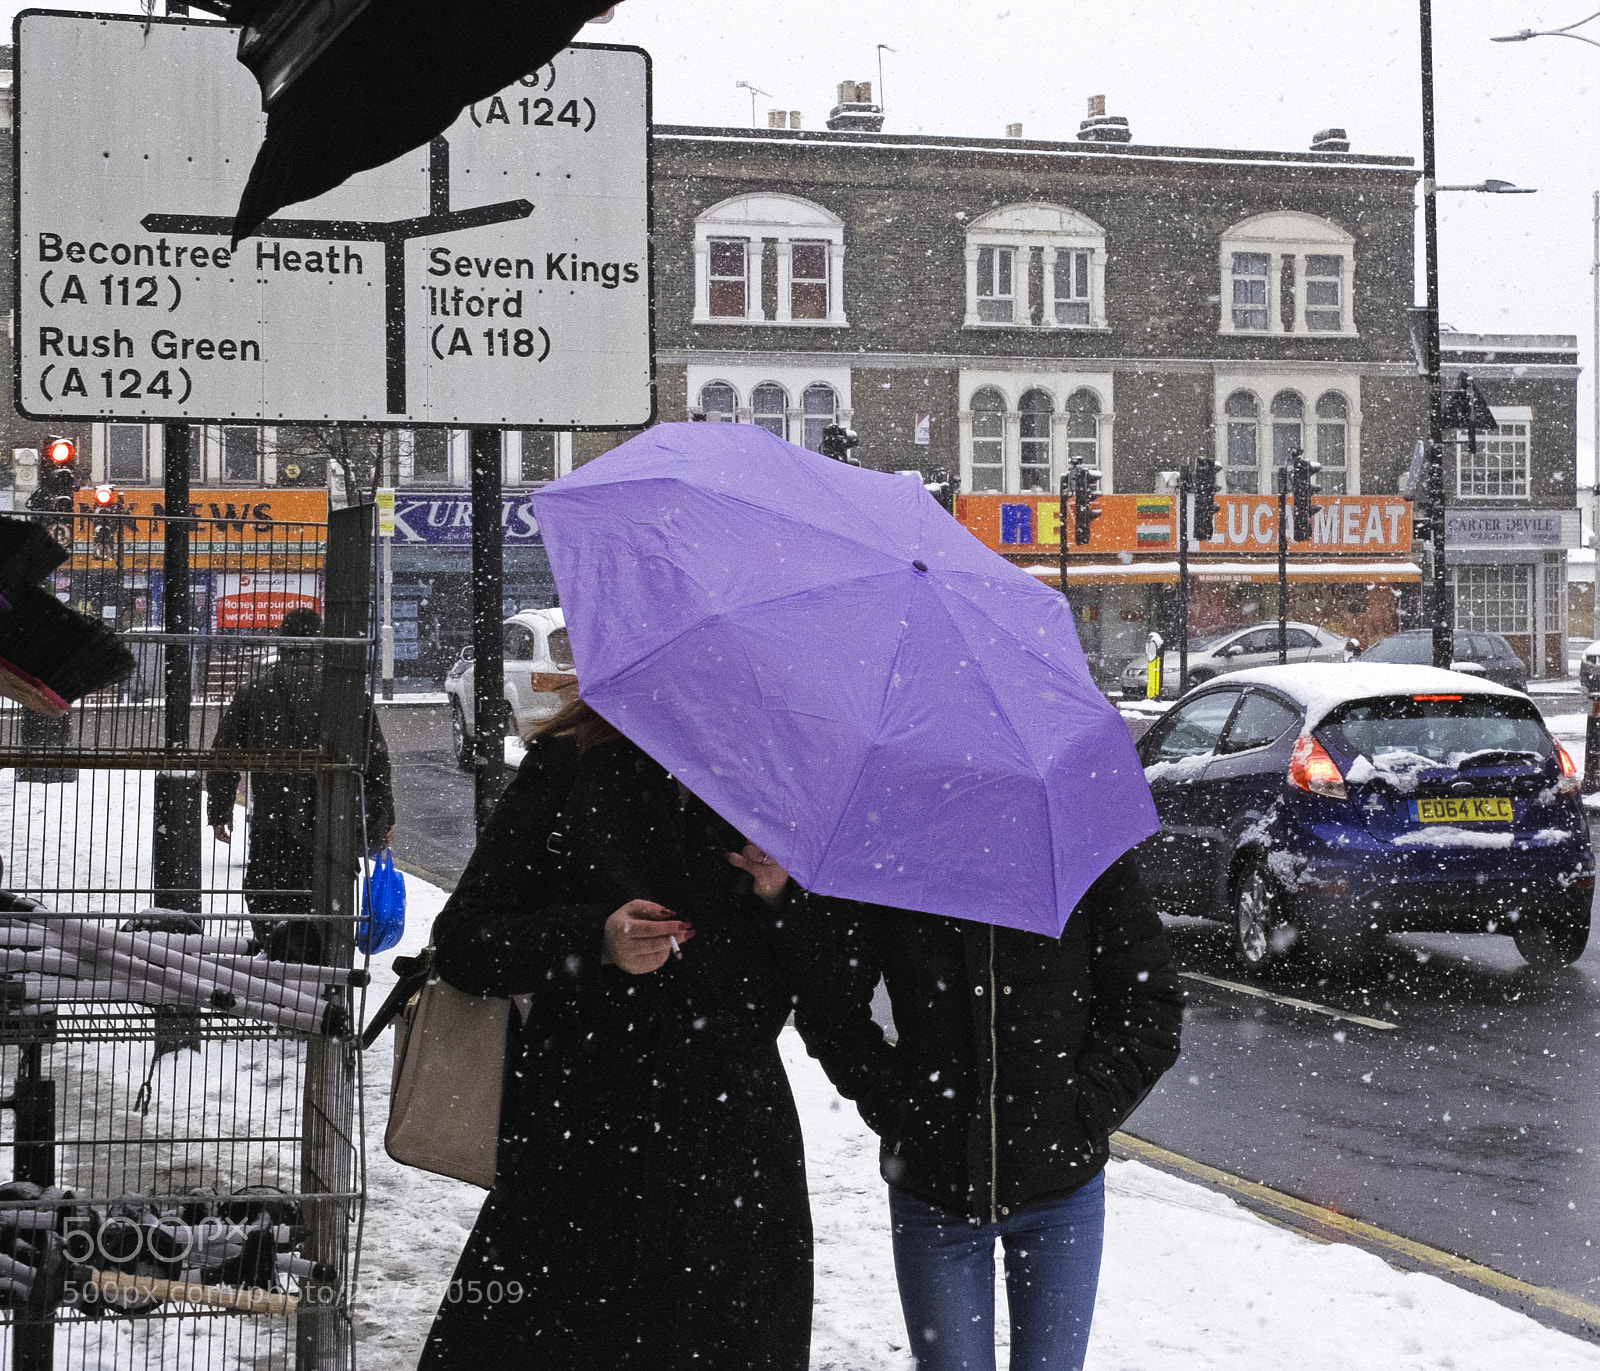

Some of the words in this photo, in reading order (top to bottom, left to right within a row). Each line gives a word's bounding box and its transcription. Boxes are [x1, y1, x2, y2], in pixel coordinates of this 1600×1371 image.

[40, 233, 232, 269] Becontree
[256, 242, 363, 275] Heath
[428, 247, 534, 280] Seven
[546, 252, 639, 290] Kings
[429, 285, 523, 318] Ilford
[40, 326, 134, 358] Rush
[151, 329, 260, 362] Green
[392, 501, 540, 542] KURIS
[1313, 504, 1406, 545] MEAT
[1448, 519, 1501, 531] CARTER
[224, 600, 254, 611] Money
[257, 600, 294, 609] around
[296, 600, 314, 609] the
[226, 611, 254, 620] world
[256, 611, 267, 620] in
